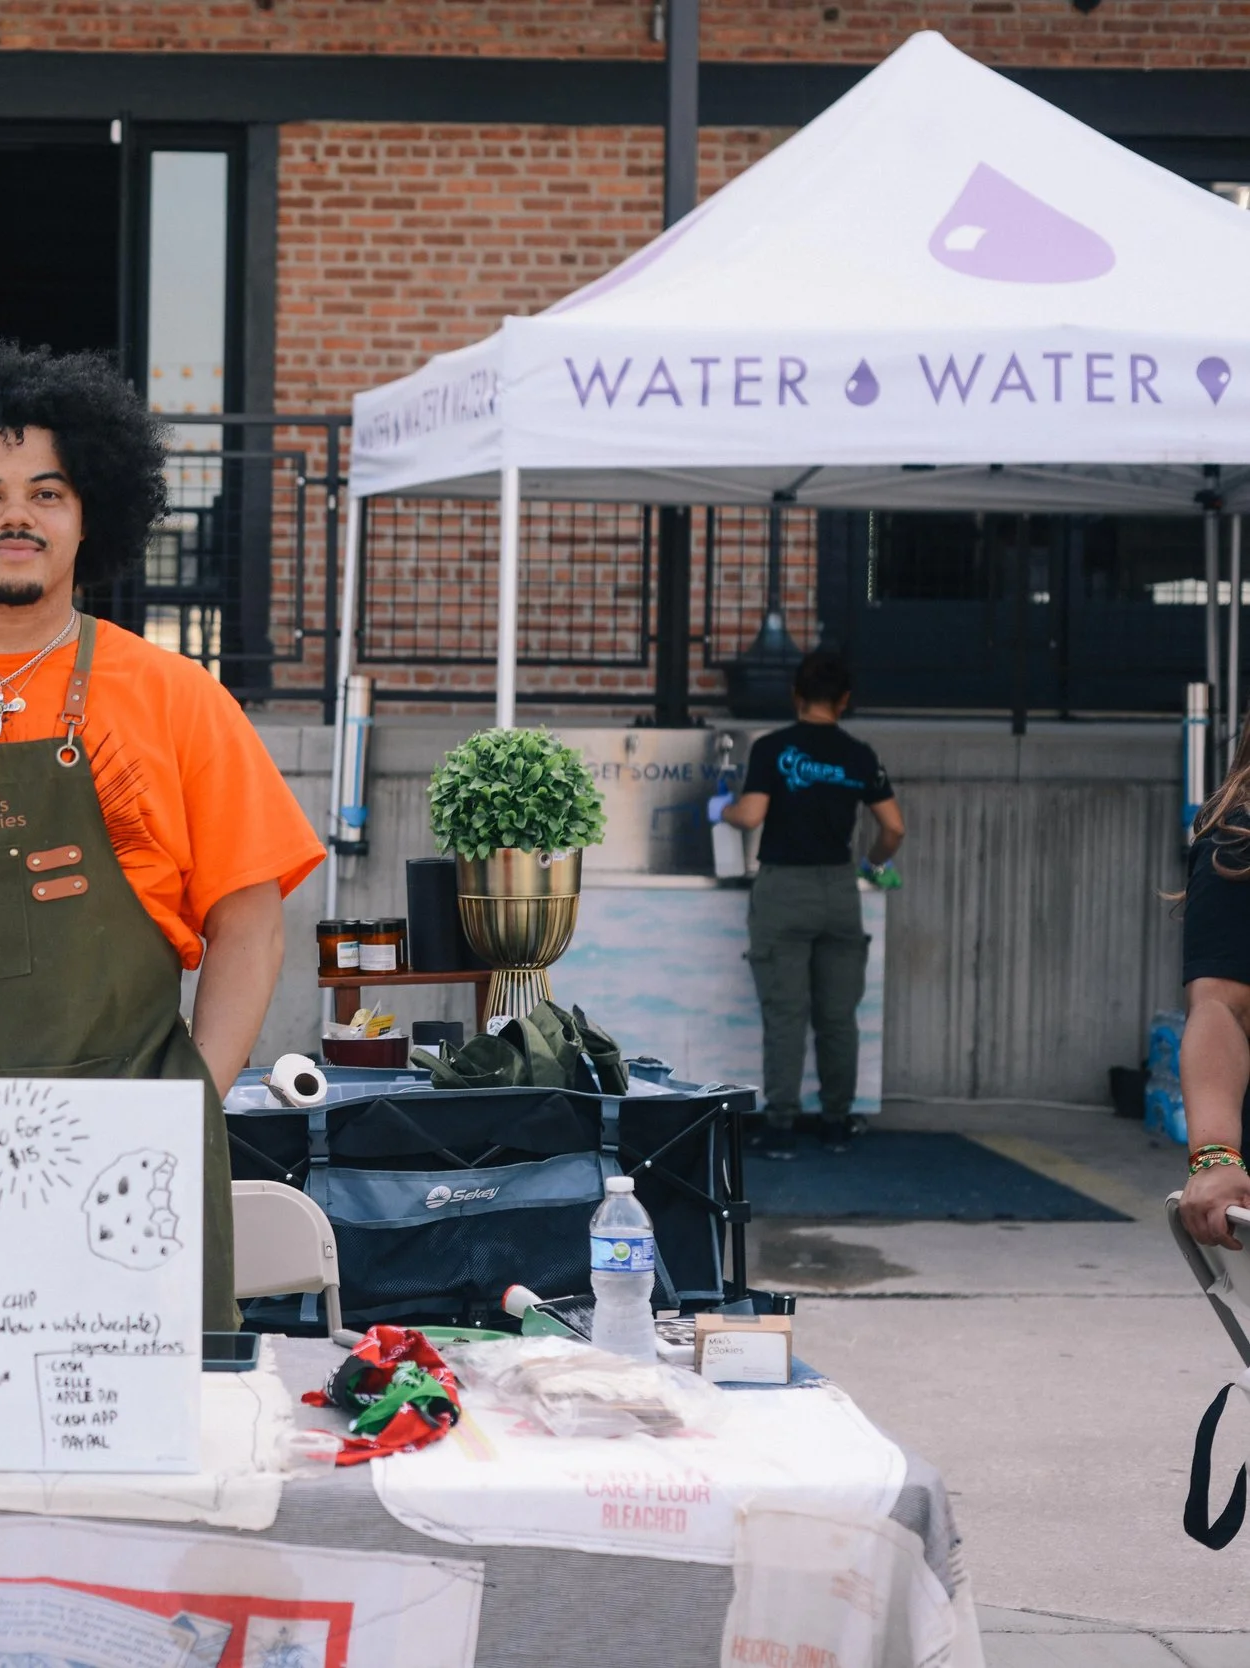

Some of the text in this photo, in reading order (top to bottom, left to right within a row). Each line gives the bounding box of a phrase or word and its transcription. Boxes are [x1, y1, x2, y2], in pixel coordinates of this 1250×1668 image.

[564, 356, 809, 408] WATER
[918, 351, 1163, 406] WATER
[630, 761, 694, 782] SOME
[15, 1115, 42, 1138] for
[2, 1290, 38, 1310] CHIP
[53, 1313, 87, 1333] white
[708, 1336, 731, 1345] Miki's
[707, 1346, 744, 1356] Cookies
[50, 1361, 84, 1373] CASH
[54, 1377, 92, 1389] ZELLE
[56, 1390, 93, 1404] APPLE
[92, 1410, 118, 1426] APP
[61, 1434, 111, 1451] PAYPAL
[585, 1481, 711, 1505] CAKE FLOUR
[602, 1503, 688, 1534] BLEACHED
